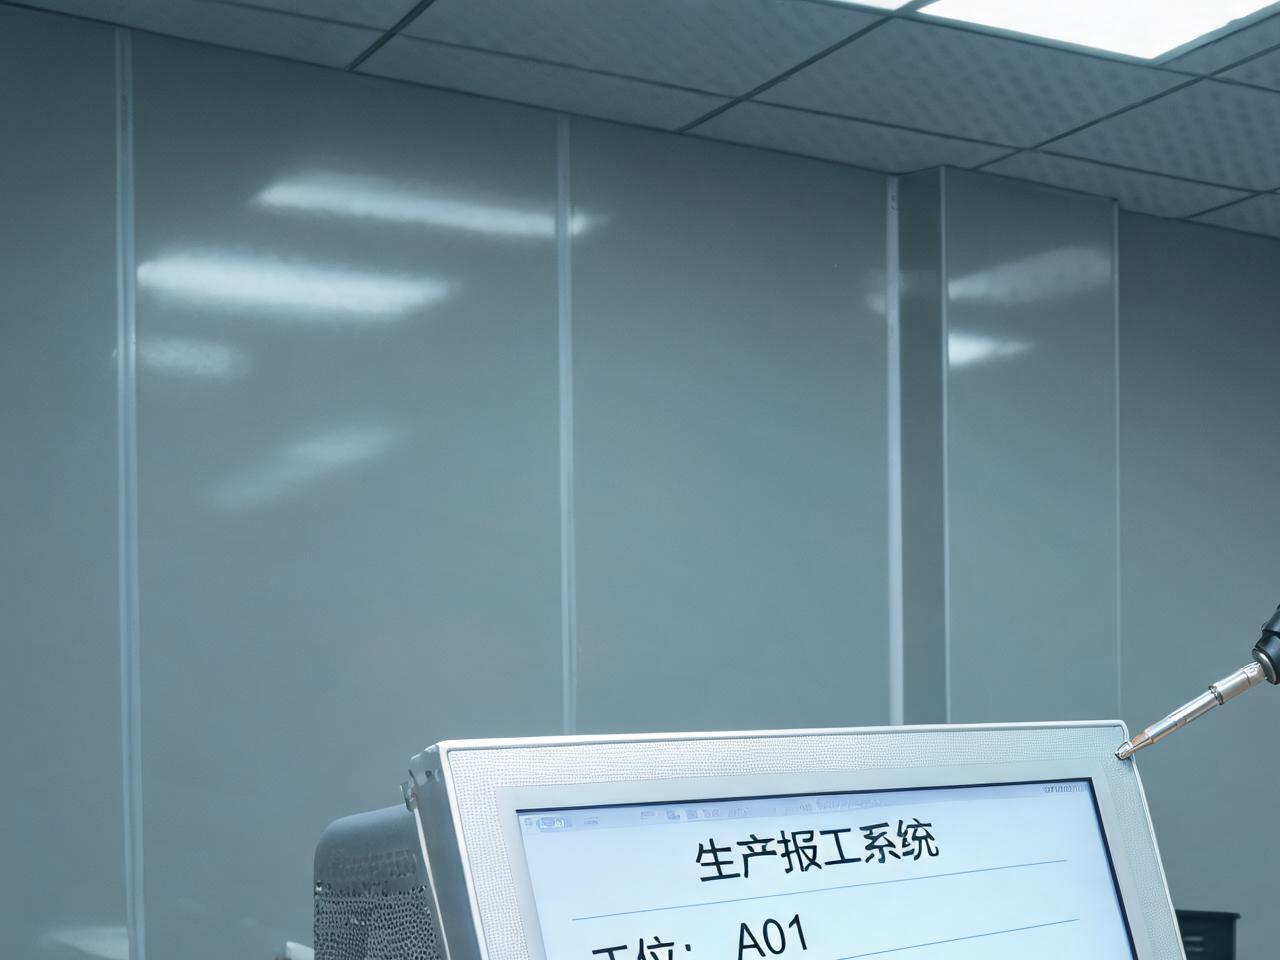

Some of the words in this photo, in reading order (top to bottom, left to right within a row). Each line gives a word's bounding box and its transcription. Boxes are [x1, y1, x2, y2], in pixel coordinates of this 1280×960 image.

[695, 817, 940, 882] 生产报工系统
